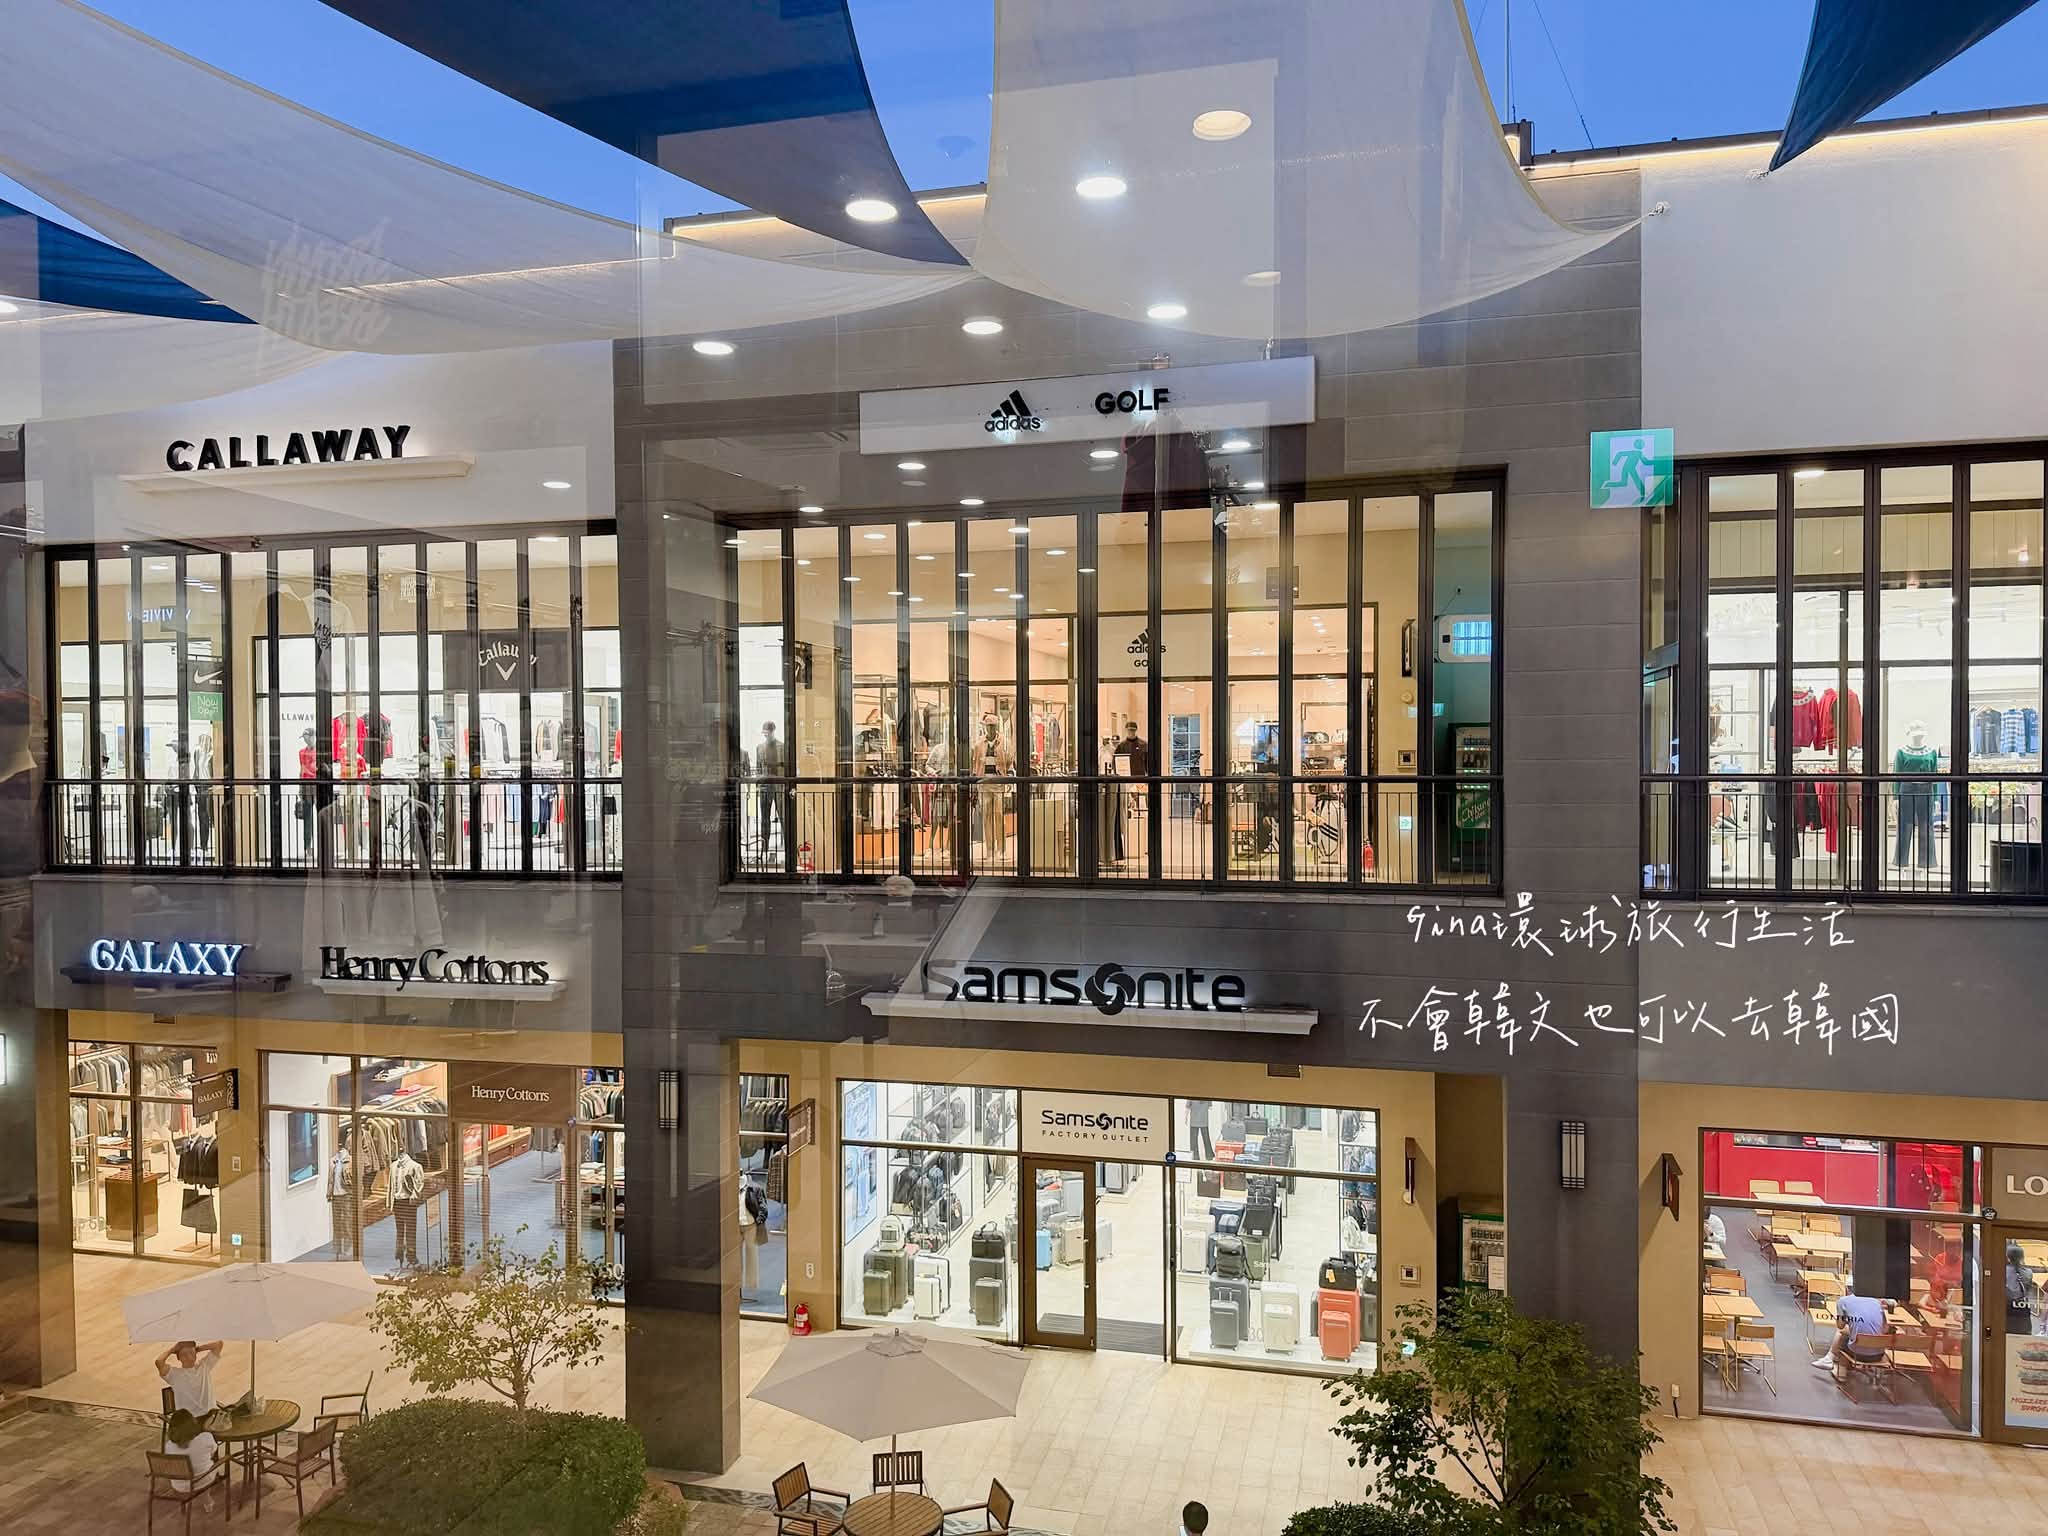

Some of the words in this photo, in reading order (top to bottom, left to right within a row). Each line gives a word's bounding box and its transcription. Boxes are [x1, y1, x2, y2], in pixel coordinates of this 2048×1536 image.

[984, 416, 1041, 432] adidas
[1095, 388, 1169, 414] GOLF
[166, 425, 411, 472] CALLAWAY
[479, 641, 539, 667] Callawy
[1127, 643, 1167, 654] adis
[91, 939, 243, 977] GALAXY
[319, 946, 417, 991] Henry
[923, 960, 1247, 1015] Samsonite
[197, 1090, 223, 1104] GALAXY
[471, 1085, 505, 1102] Henry
[1041, 1109, 1149, 1131] Samsonite
[1042, 1130, 1096, 1140] FACTORY
[1102, 1133, 1149, 1143] OUTLET
